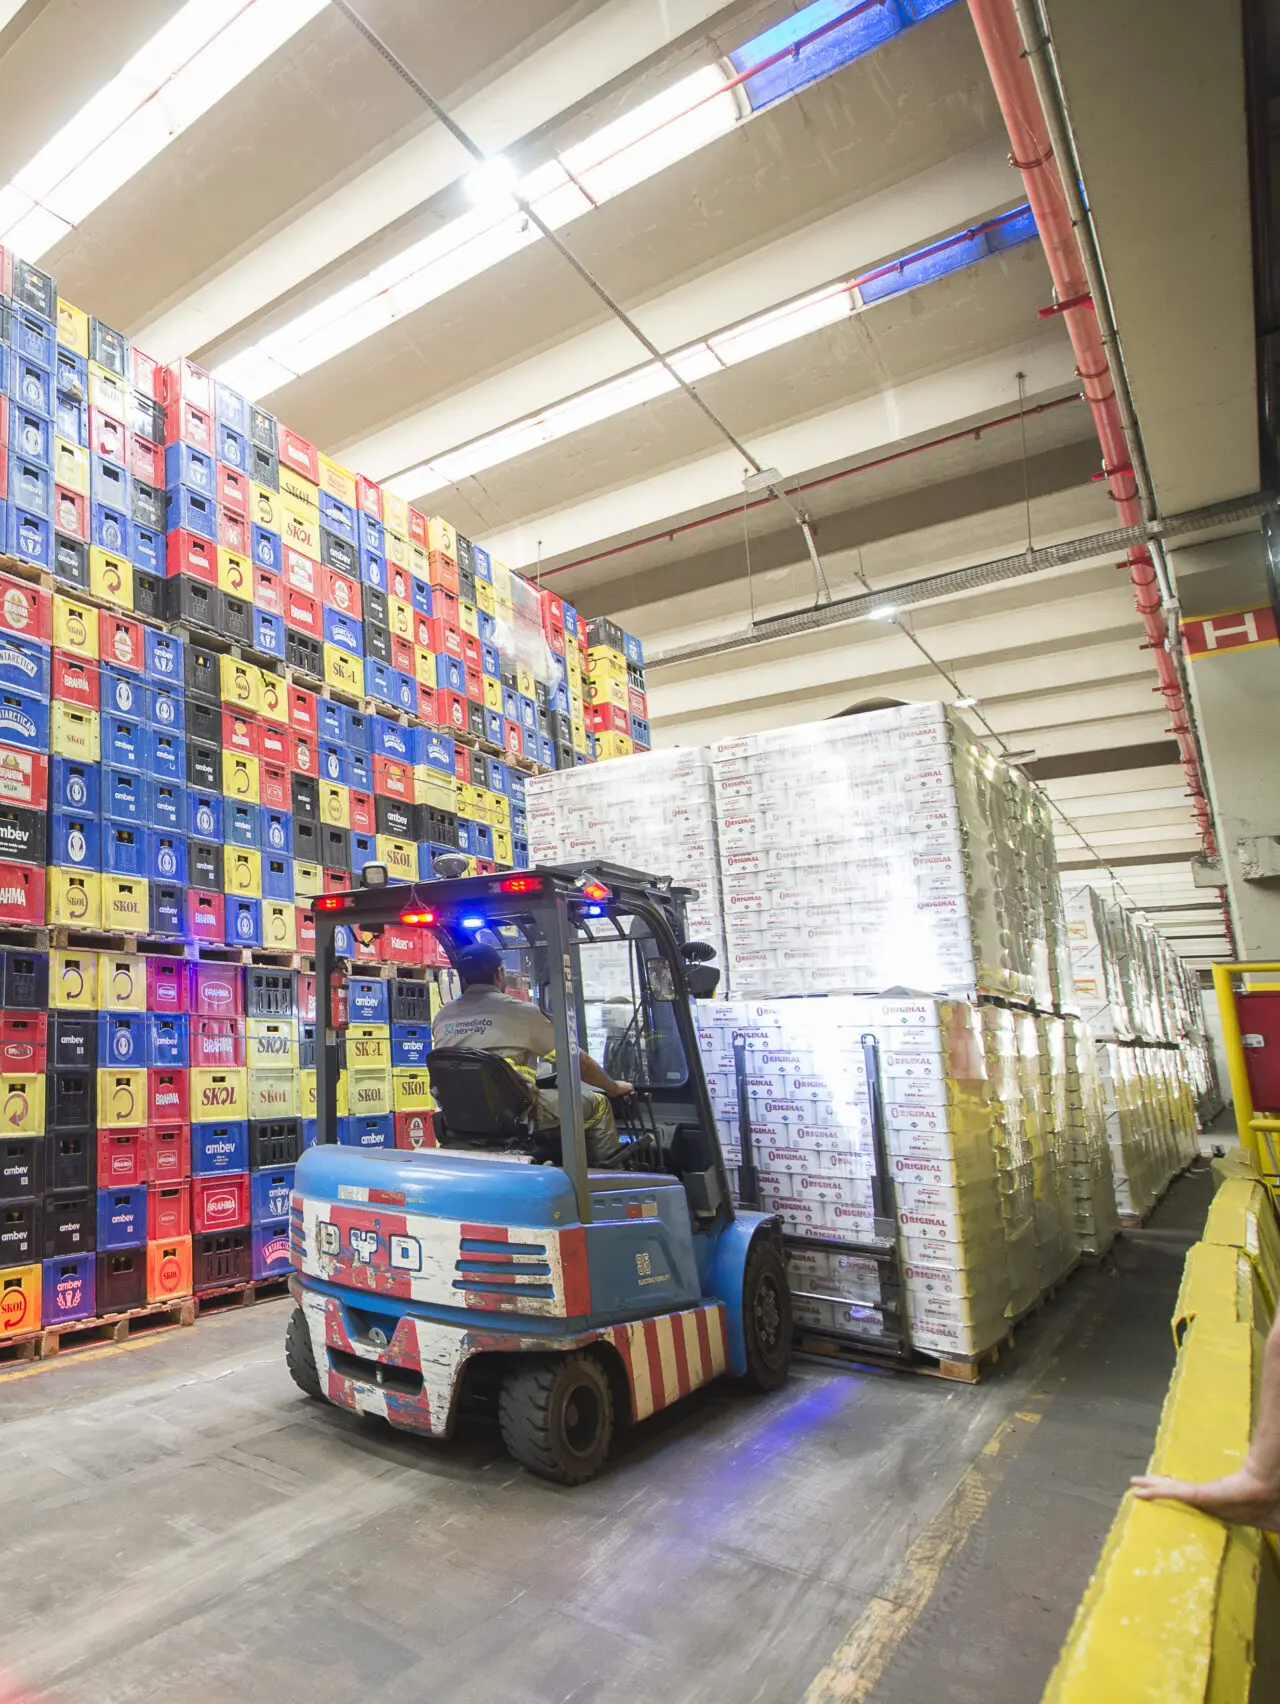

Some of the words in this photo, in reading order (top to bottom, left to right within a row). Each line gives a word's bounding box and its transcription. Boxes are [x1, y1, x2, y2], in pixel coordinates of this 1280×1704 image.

[728, 856, 759, 867] ORIGINAL
[730, 894, 762, 904] ORIGINAL
[113, 901, 140, 913] SKOL
[159, 906, 177, 915] ambev
[205, 989, 229, 998] BRAHMA
[355, 996, 378, 1007] ambev
[61, 1036, 83, 1044] ambev
[203, 1037, 232, 1053] BRAHMA
[358, 1088, 383, 1101] SKOL
[402, 1082, 427, 1096] SKOL
[765, 1102, 804, 1113] ORIGINAL
[361, 1133, 384, 1144] ambev
[206, 1142, 235, 1155] ambev
[768, 1151, 808, 1162] ORIGINAL
[4, 1165, 28, 1175] ambev
[896, 1160, 942, 1172] ORIGINAL
[801, 1178, 843, 1190] ORIGINAL
[207, 1201, 235, 1212] BRAHMA
[772, 1201, 813, 1212] ORIGINAL
[112, 1214, 133, 1223] ambev
[900, 1213, 948, 1228] ORIGINAL
[60, 1222, 80, 1232] ambev
[1, 1230, 28, 1241] ambev
[57, 1279, 82, 1290] ambev
[1, 1302, 24, 1314] SKOL
